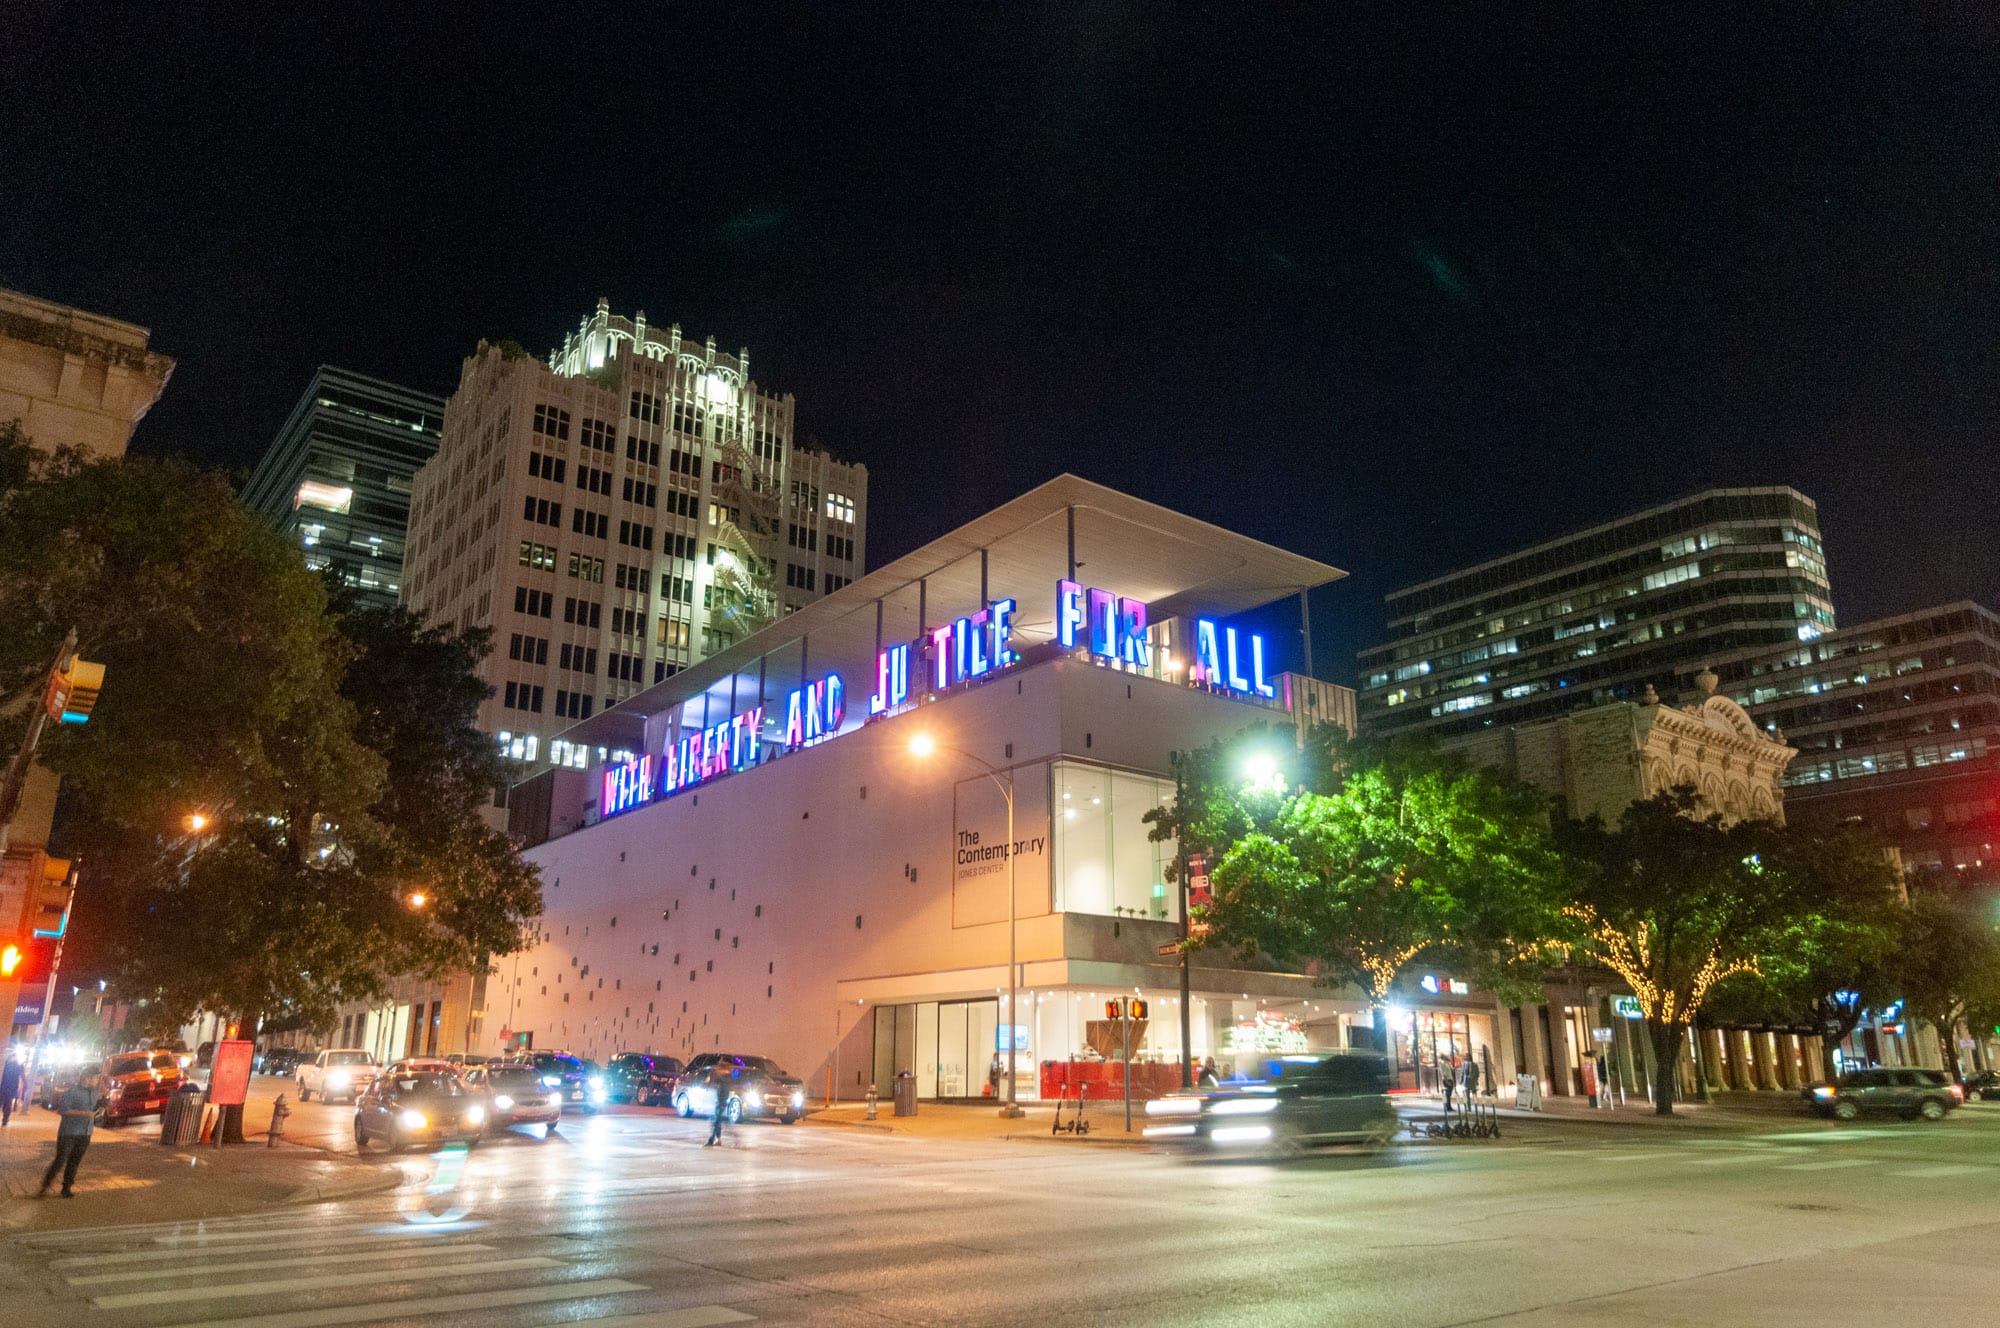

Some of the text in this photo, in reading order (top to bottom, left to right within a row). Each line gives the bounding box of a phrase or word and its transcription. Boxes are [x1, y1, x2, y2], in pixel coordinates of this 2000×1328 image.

[1056, 578, 1276, 699] FOR ALL
[602, 754, 653, 807] WITH
[664, 705, 764, 794] LIBERTY
[786, 671, 846, 750] AND
[958, 828, 979, 847] The
[958, 863, 1004, 880] JONES CENTER
